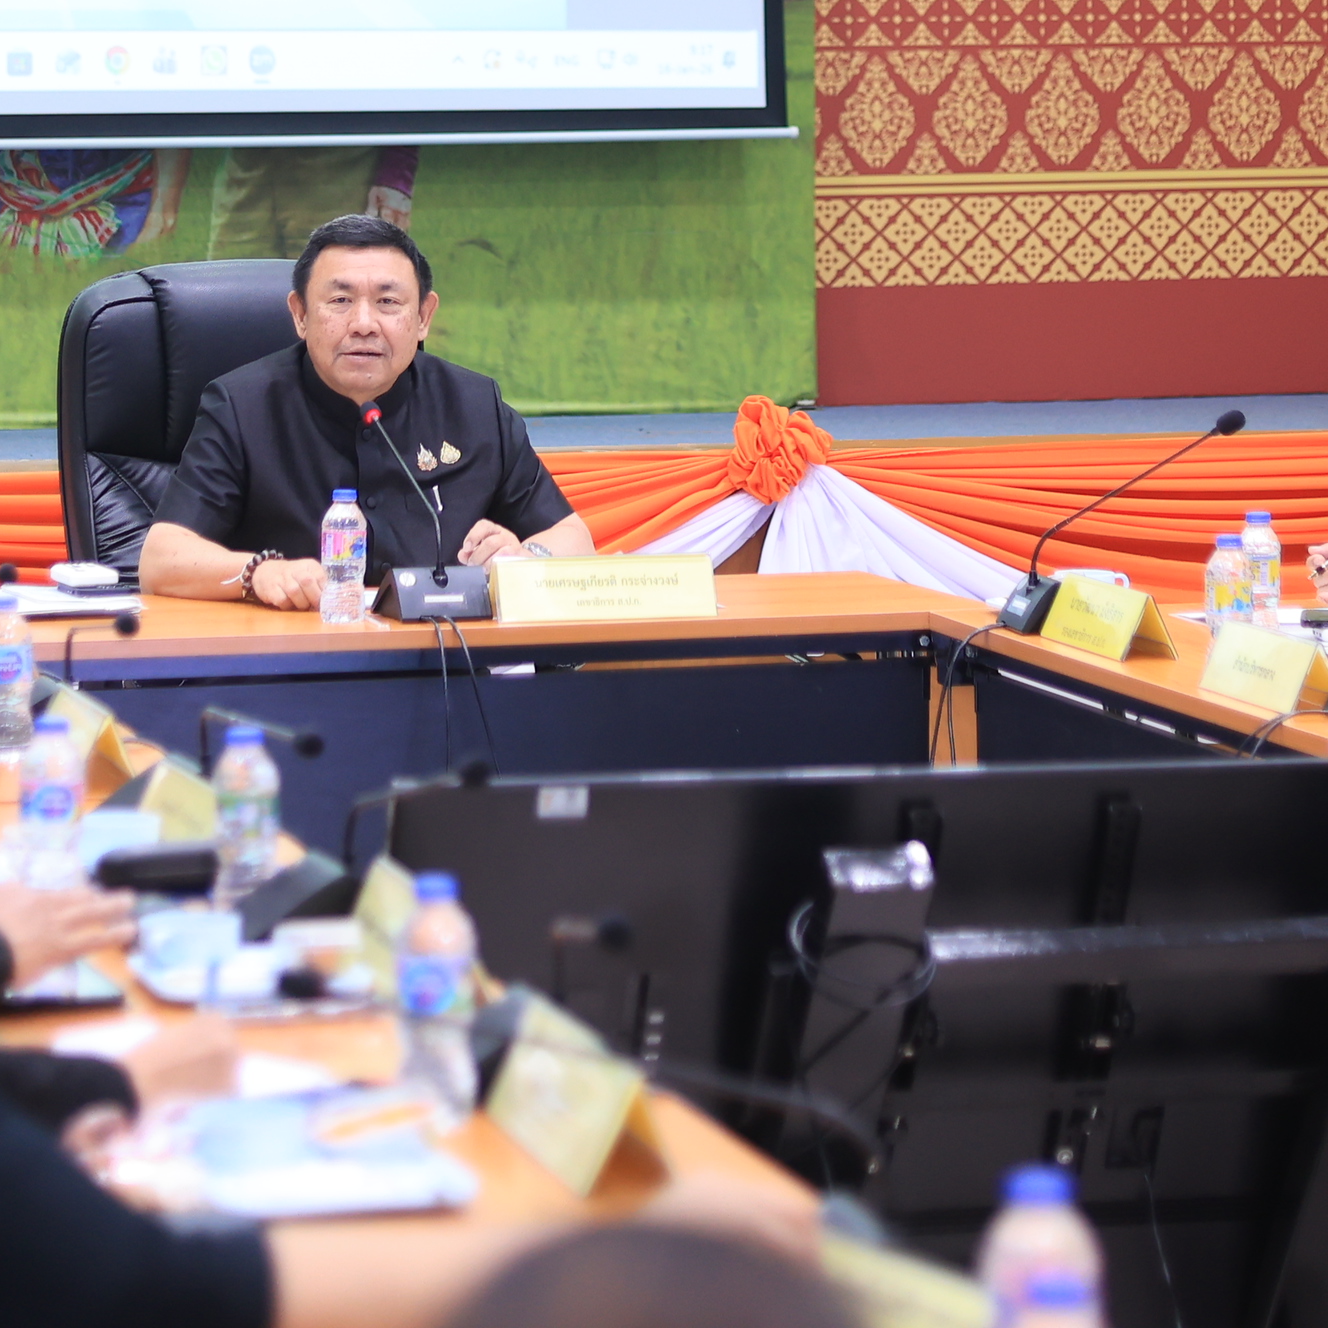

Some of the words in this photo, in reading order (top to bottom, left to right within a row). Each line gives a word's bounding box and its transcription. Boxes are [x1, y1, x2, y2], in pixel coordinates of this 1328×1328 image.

[534, 574, 617, 591] นายเศรษฐเกียรติ
[621, 572, 679, 588] กระจ่างวงษ์
[577, 596, 615, 608] เลขาธิการ
